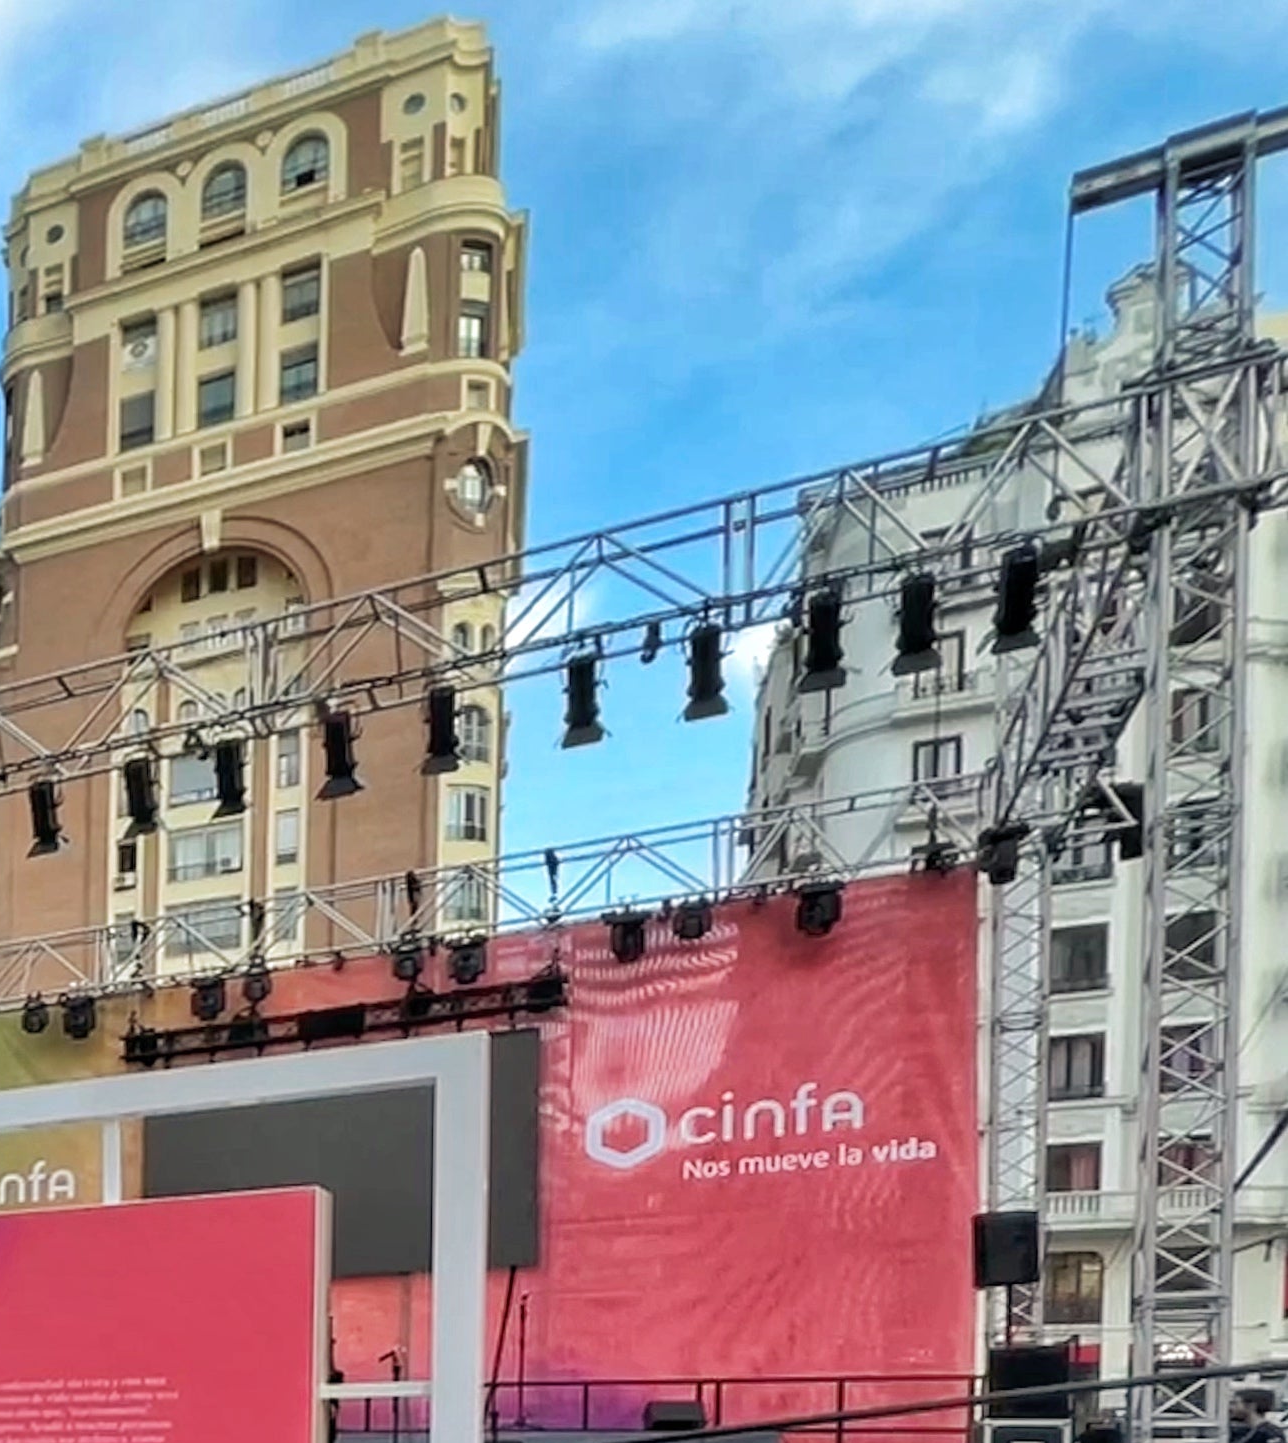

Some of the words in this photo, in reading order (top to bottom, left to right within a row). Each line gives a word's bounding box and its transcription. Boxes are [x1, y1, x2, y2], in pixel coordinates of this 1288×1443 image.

[683, 1158, 731, 1180] Nos
[738, 1150, 829, 1175] mueve
[838, 1144, 863, 1166] la
[872, 1137, 937, 1163] vida
